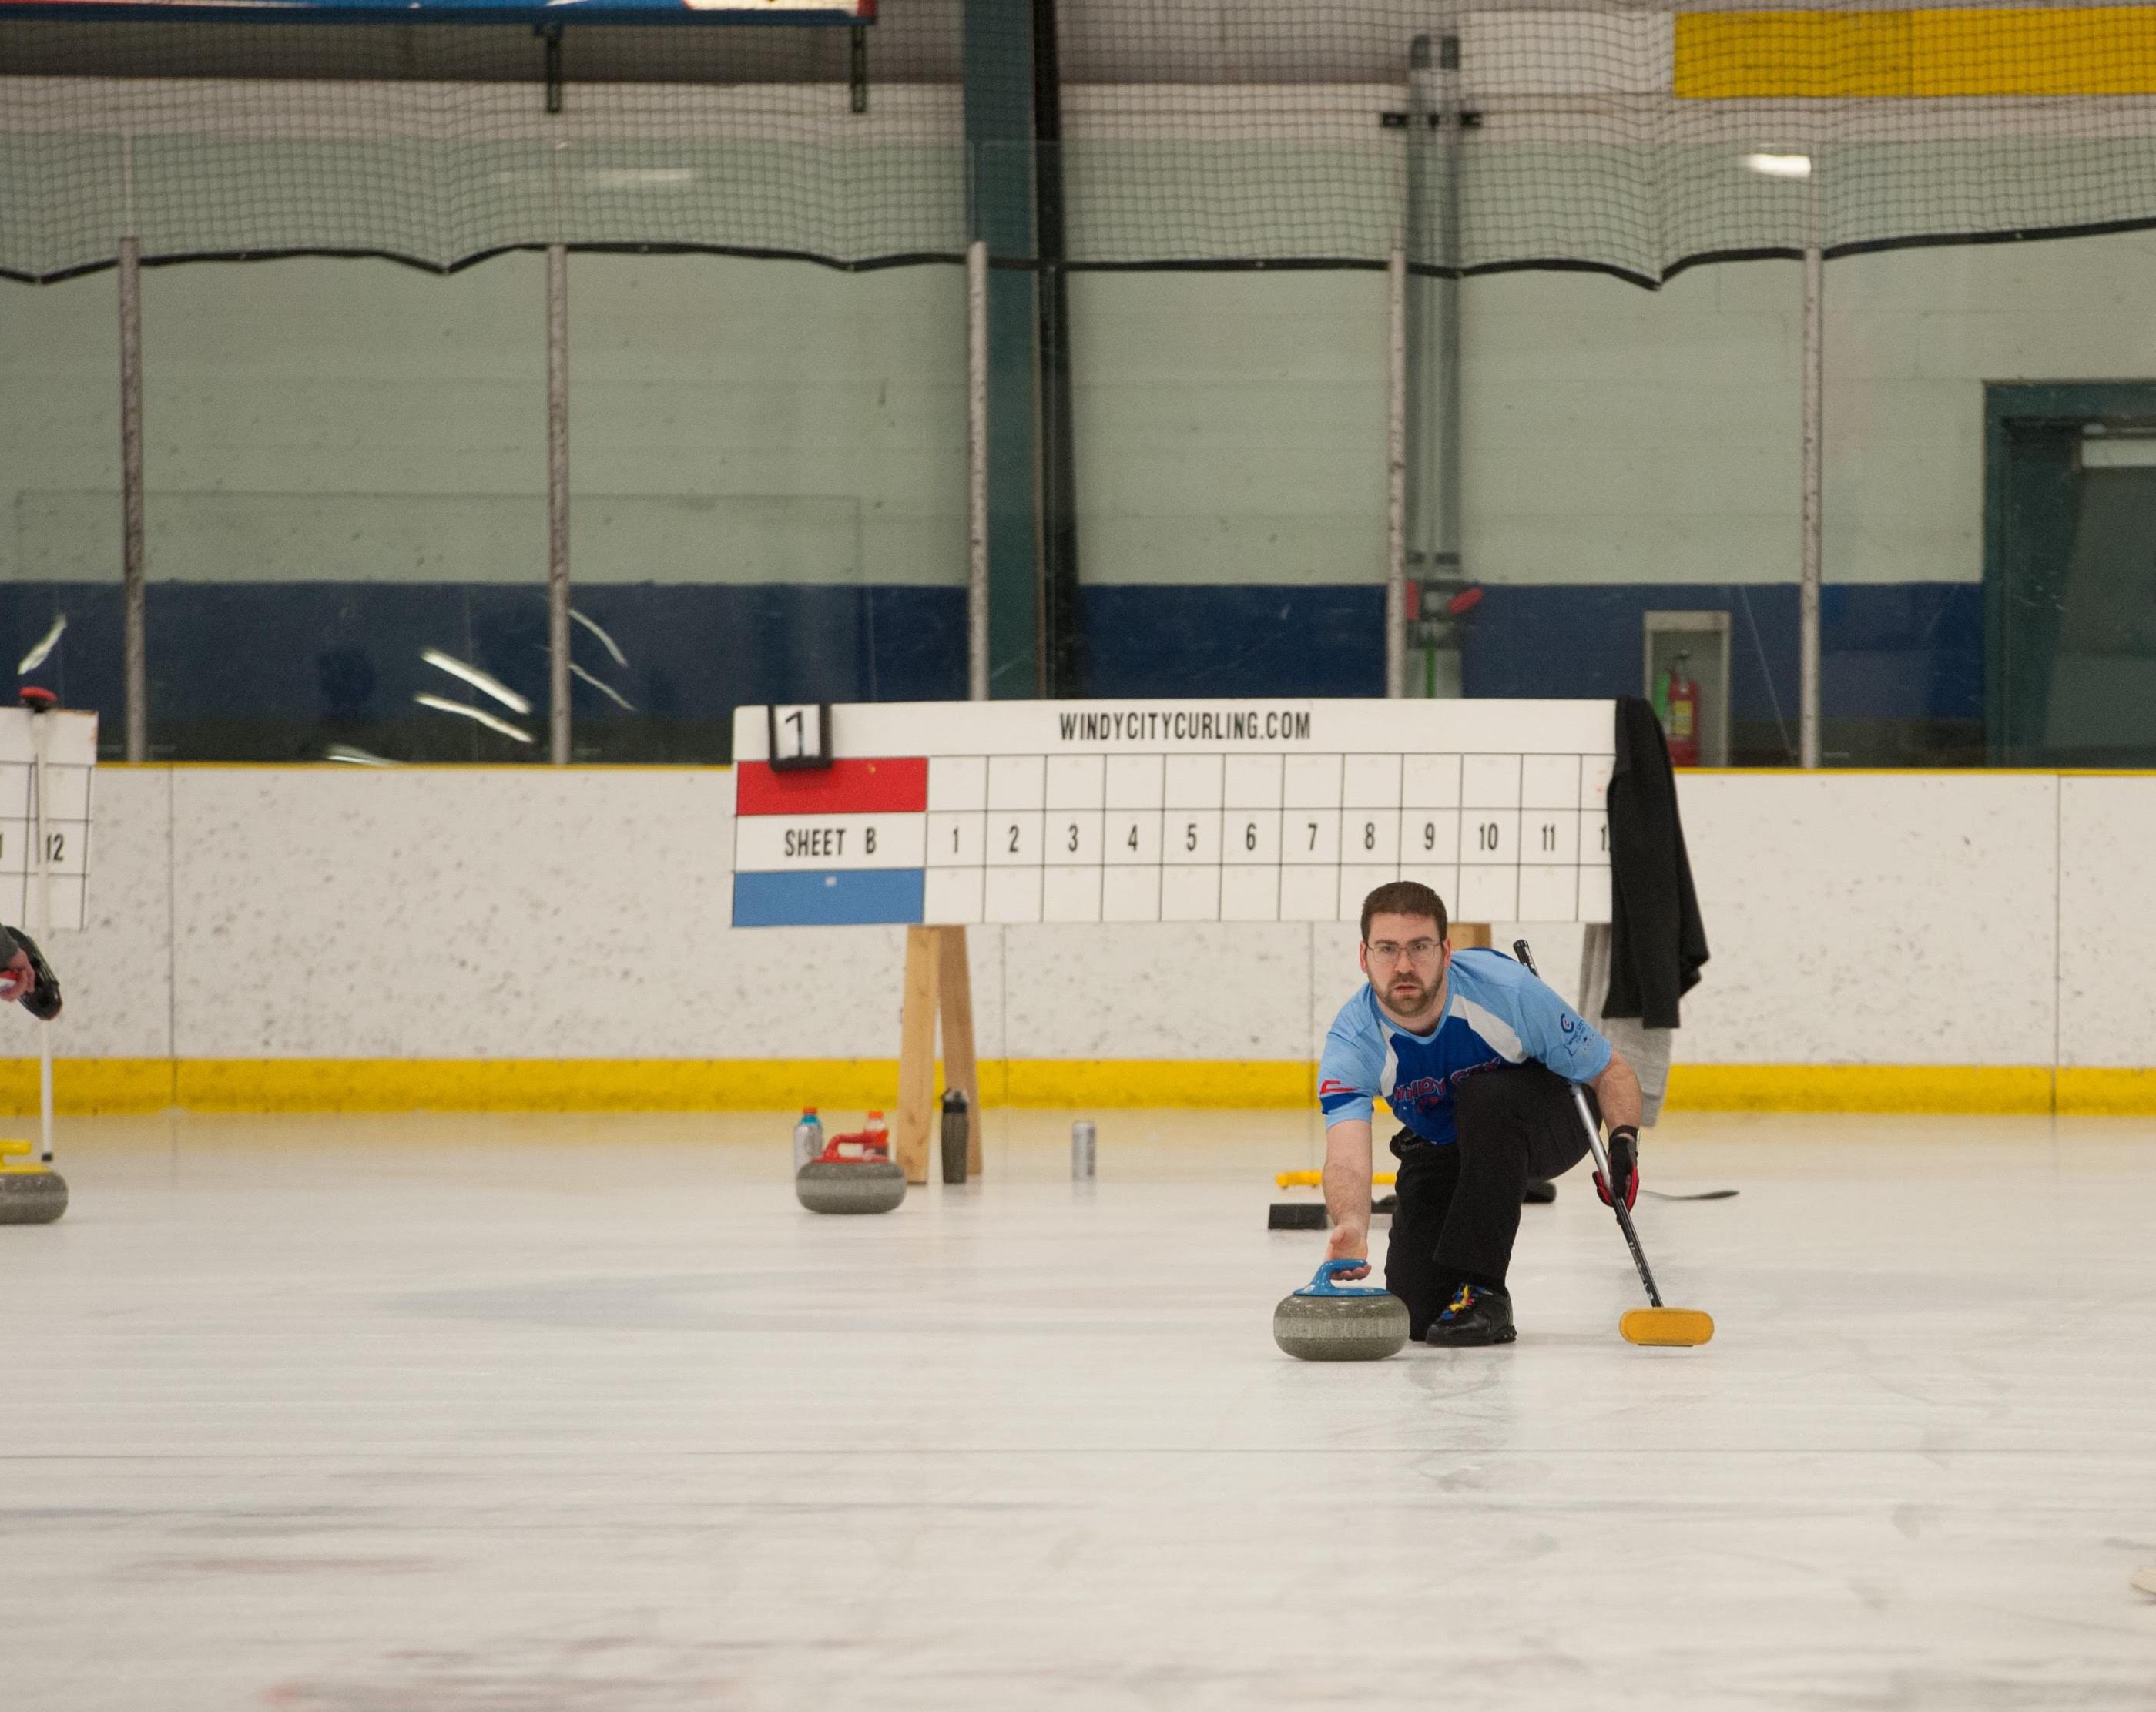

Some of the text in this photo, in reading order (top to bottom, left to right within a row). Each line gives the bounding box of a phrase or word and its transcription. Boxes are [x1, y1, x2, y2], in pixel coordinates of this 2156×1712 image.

[785, 711, 803, 755] 1
[1059, 711, 1309, 740] WINDYCITYCURLING.COM
[47, 834, 64, 861] 12
[785, 826, 876, 856] SHEET B
[952, 826, 959, 853] 1
[1008, 825, 1019, 853] 2
[1068, 824, 1078, 853] 3
[1128, 824, 1138, 851] 4
[1186, 823, 1197, 852] 5
[1246, 822, 1256, 851] 6
[1308, 822, 1318, 851] 7
[1364, 822, 1375, 850] 8
[1424, 822, 1435, 851] 9
[1479, 822, 1498, 851] 10
[1542, 823, 1555, 851] 11
[1394, 1077, 1446, 1102] WNDY
